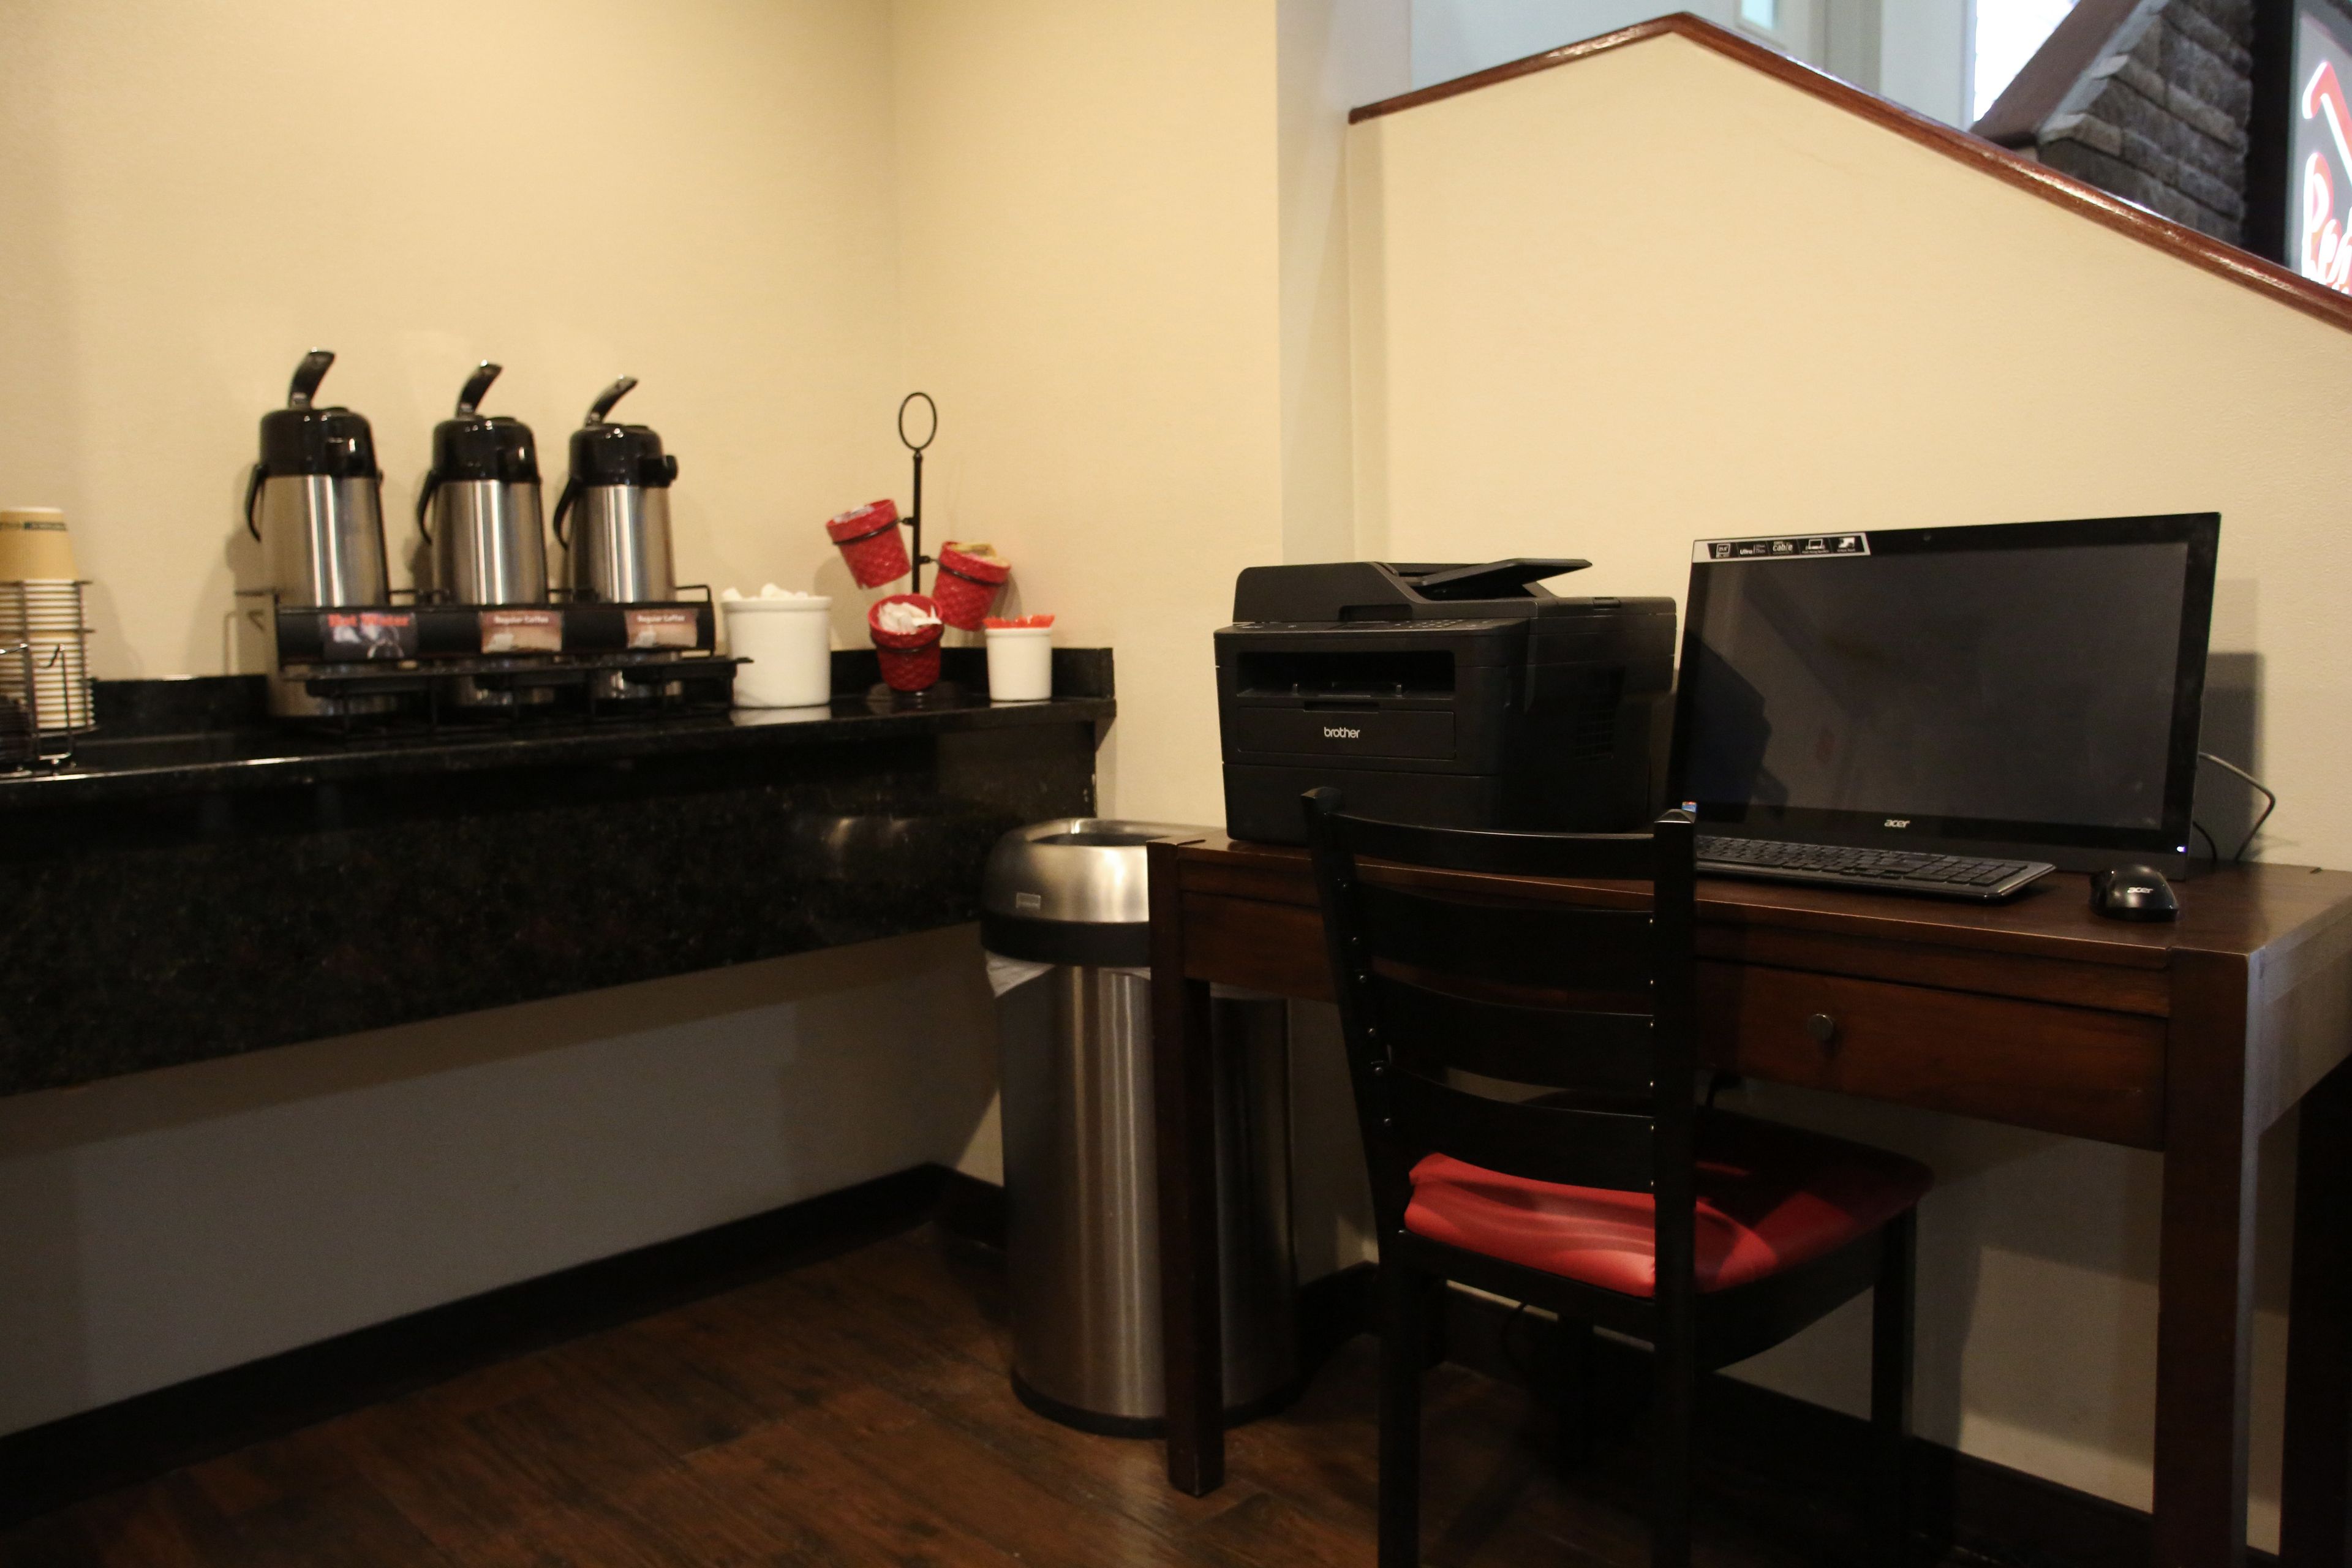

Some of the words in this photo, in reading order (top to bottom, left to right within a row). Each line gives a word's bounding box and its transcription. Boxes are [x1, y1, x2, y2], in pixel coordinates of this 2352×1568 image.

[1773, 542, 1793, 552] cable
[327, 614, 357, 628] Hot
[493, 614, 523, 624] Regular
[524, 614, 549, 624] Coffee
[1324, 726, 1360, 739] brother
[1884, 820, 1910, 828] acer
